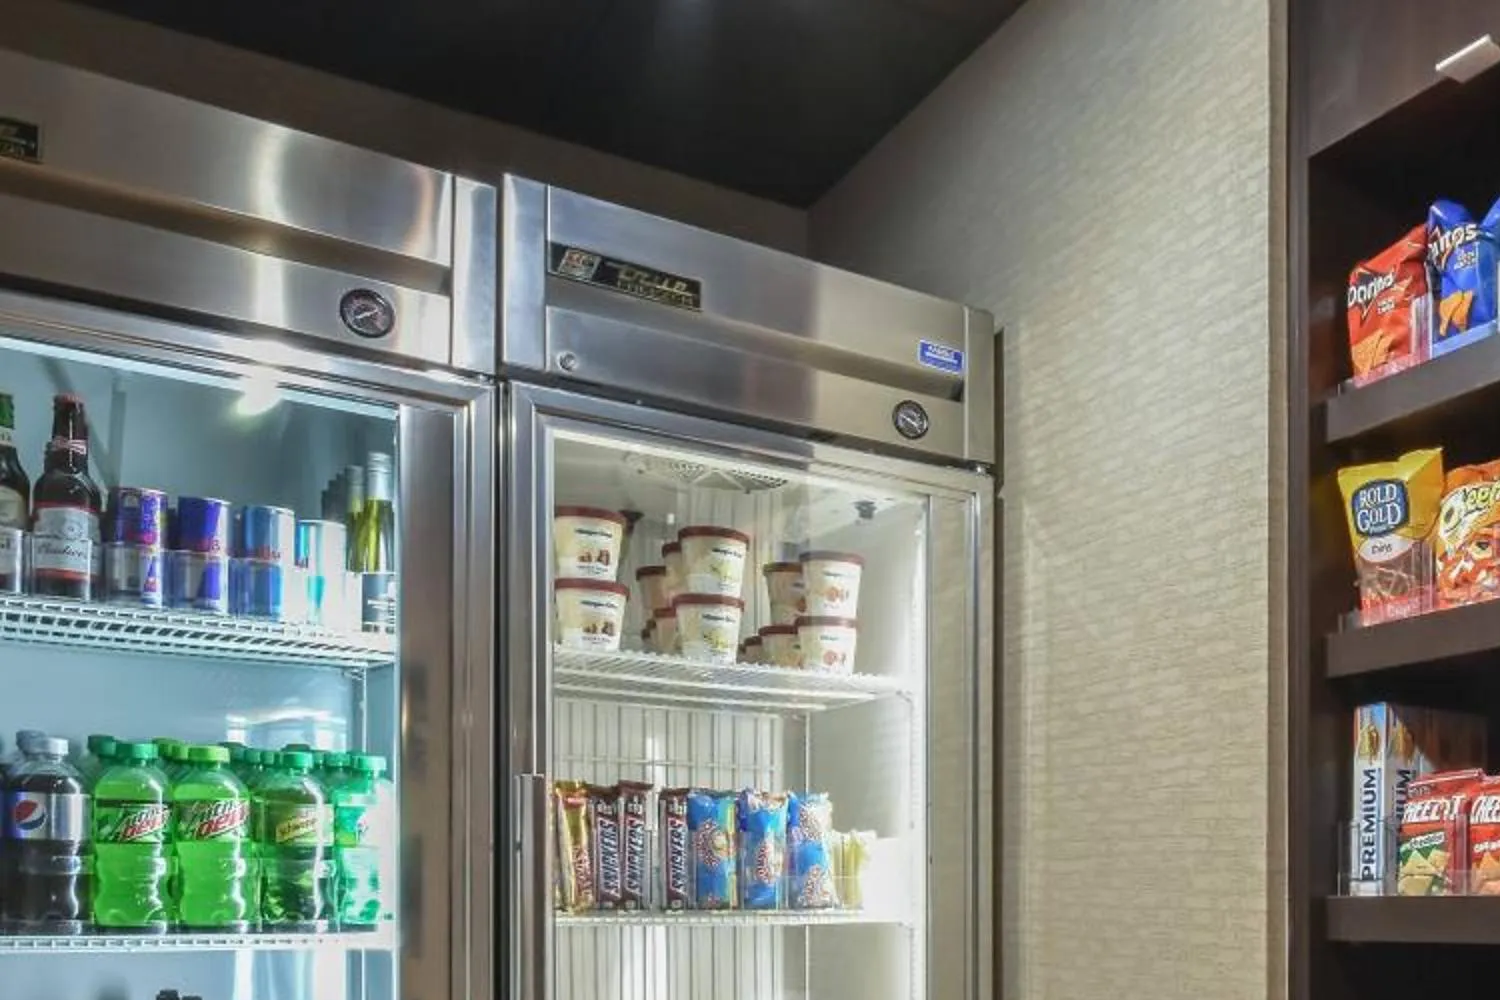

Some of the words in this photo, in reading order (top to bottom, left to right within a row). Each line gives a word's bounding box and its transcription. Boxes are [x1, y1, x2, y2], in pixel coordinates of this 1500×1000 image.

[1359, 484, 1397, 508] ROLD
[1356, 503, 1401, 533] GOLD
[1361, 767, 1377, 881] PREMIUM
